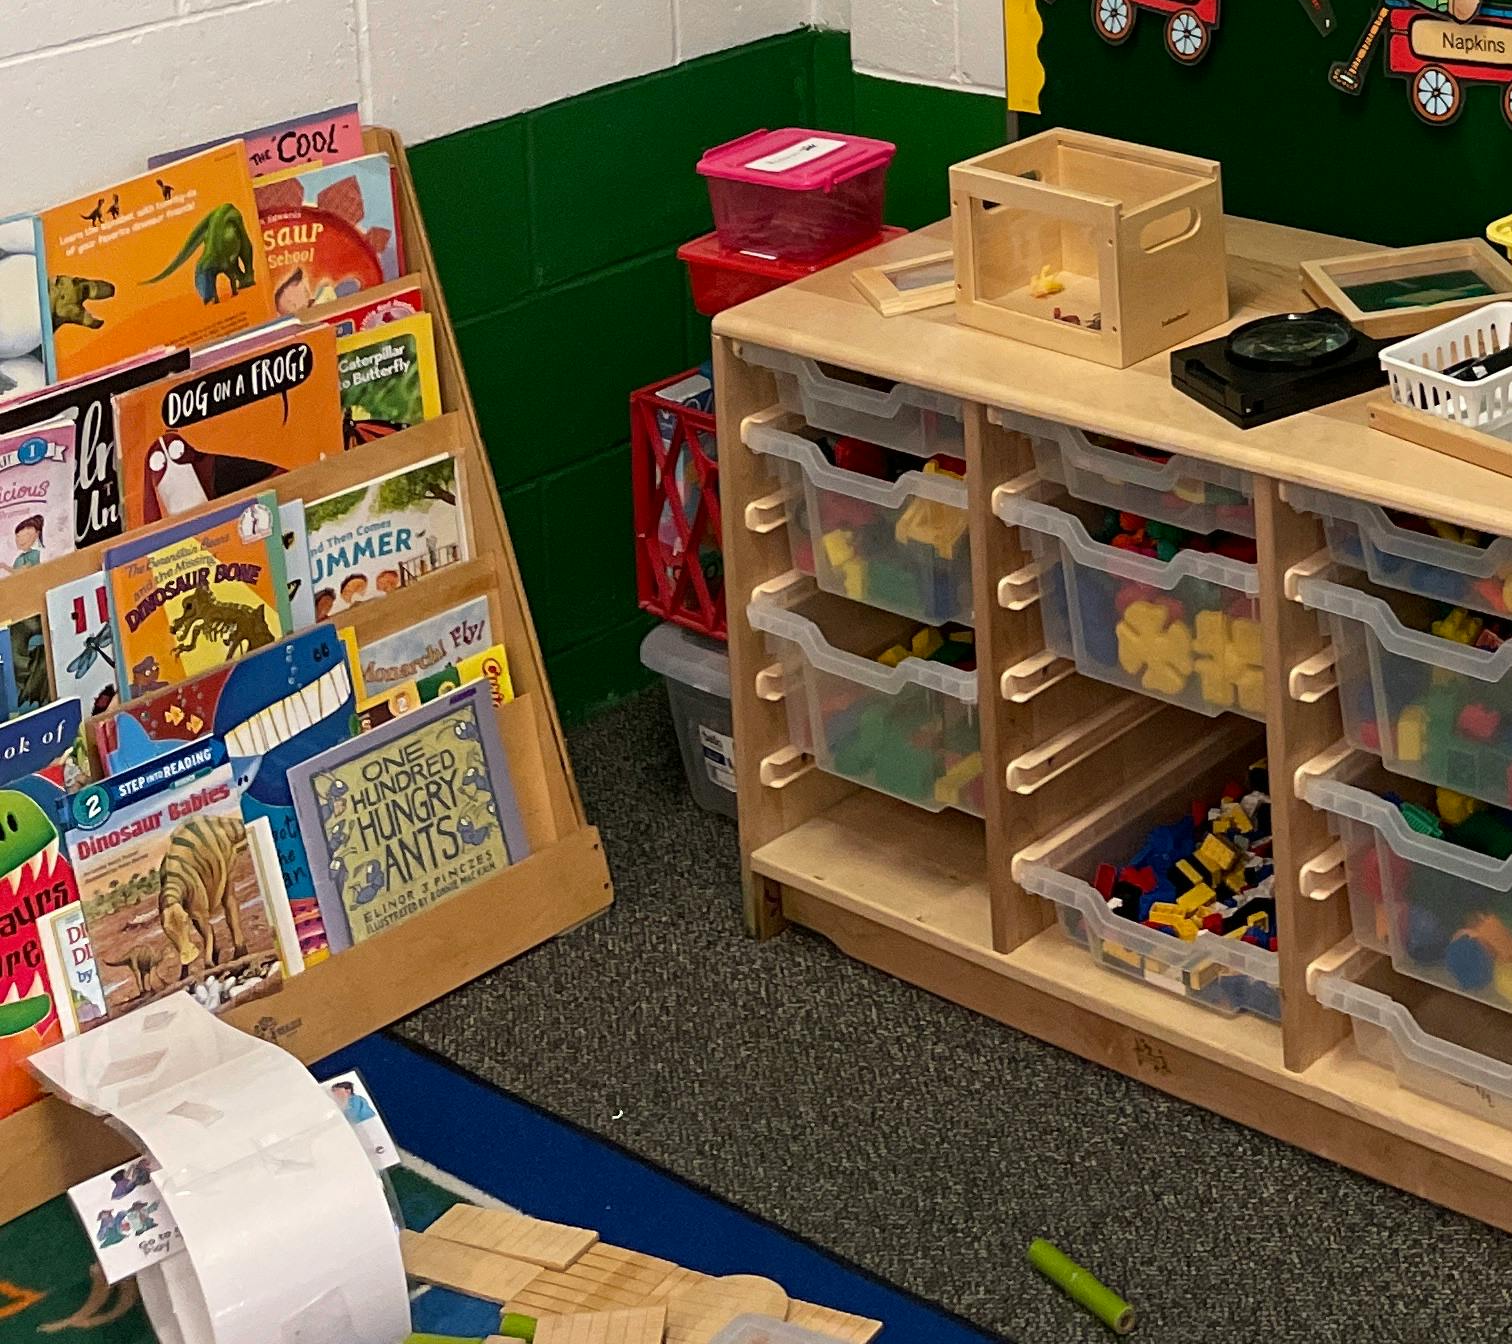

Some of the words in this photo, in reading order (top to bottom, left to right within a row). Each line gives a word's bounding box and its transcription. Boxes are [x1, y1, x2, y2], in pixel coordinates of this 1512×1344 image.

[1442, 31, 1505, 55] Napkins
[267, 248, 315, 269] School
[338, 344, 405, 373] Caterpillar
[352, 357, 411, 386] Butterfly
[168, 381, 209, 425] DOG
[213, 380, 231, 403] ON
[235, 374, 245, 396] A
[251, 345, 308, 395] FROG?
[356, 520, 391, 536] Comes
[312, 528, 412, 584] UMMER
[125, 567, 211, 632] DINOSAUR
[214, 563, 262, 585] BONE
[42, 720, 65, 744] of
[118, 776, 145, 797] STEP
[163, 748, 212, 779] READING
[351, 749, 456, 814] HUNDRED
[362, 740, 426, 782] ONE
[77, 810, 163, 861] Dinosaur
[167, 784, 231, 821] Babies
[85, 794, 102, 818] 2
[356, 768, 460, 852] HUNGRY
[385, 815, 459, 892] ANTS
[364, 891, 415, 923] ELINOR
[434, 851, 493, 888] PINCZES
